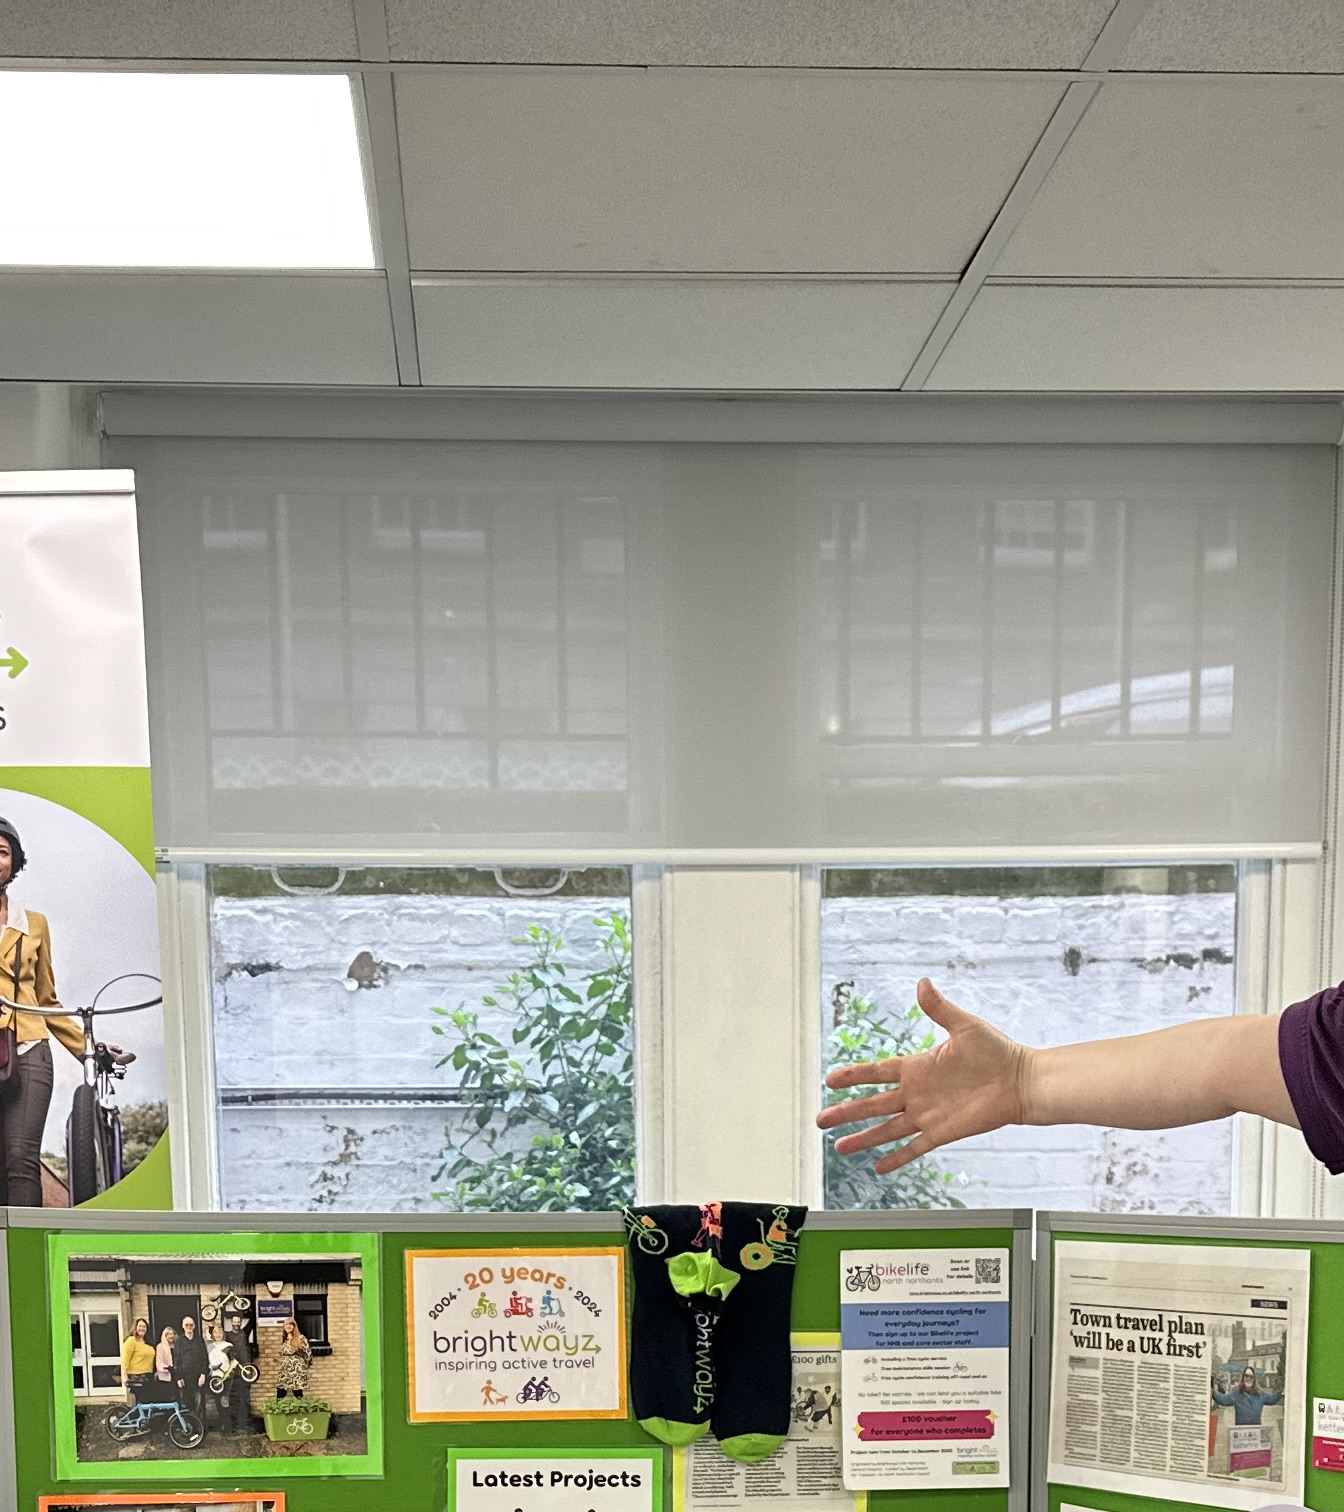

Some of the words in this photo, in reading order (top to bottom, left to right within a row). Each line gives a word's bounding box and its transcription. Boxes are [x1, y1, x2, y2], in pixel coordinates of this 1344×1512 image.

[464, 1267, 494, 1290] 20
[501, 1265, 566, 1291] years
[428, 1291, 457, 1321] 2004
[574, 1290, 603, 1318] 2024
[859, 1309, 879, 1317] Need
[946, 1308, 973, 1316] cycling
[884, 1320, 921, 1328] everyday
[1070, 1309, 1113, 1329] Town
[1116, 1311, 1165, 1333] travel
[1167, 1314, 1205, 1338] plan
[1106, 1334, 1124, 1352] be
[1127, 1341, 1136, 1353] a
[1139, 1337, 1162, 1355] UK
[435, 1358, 497, 1373] inspiring
[502, 1358, 548, 1370] active
[553, 1356, 595, 1369] travel
[816, 1355, 837, 1366] gifts
[472, 1470, 544, 1488] Latest
[550, 1469, 642, 1490] Projects
